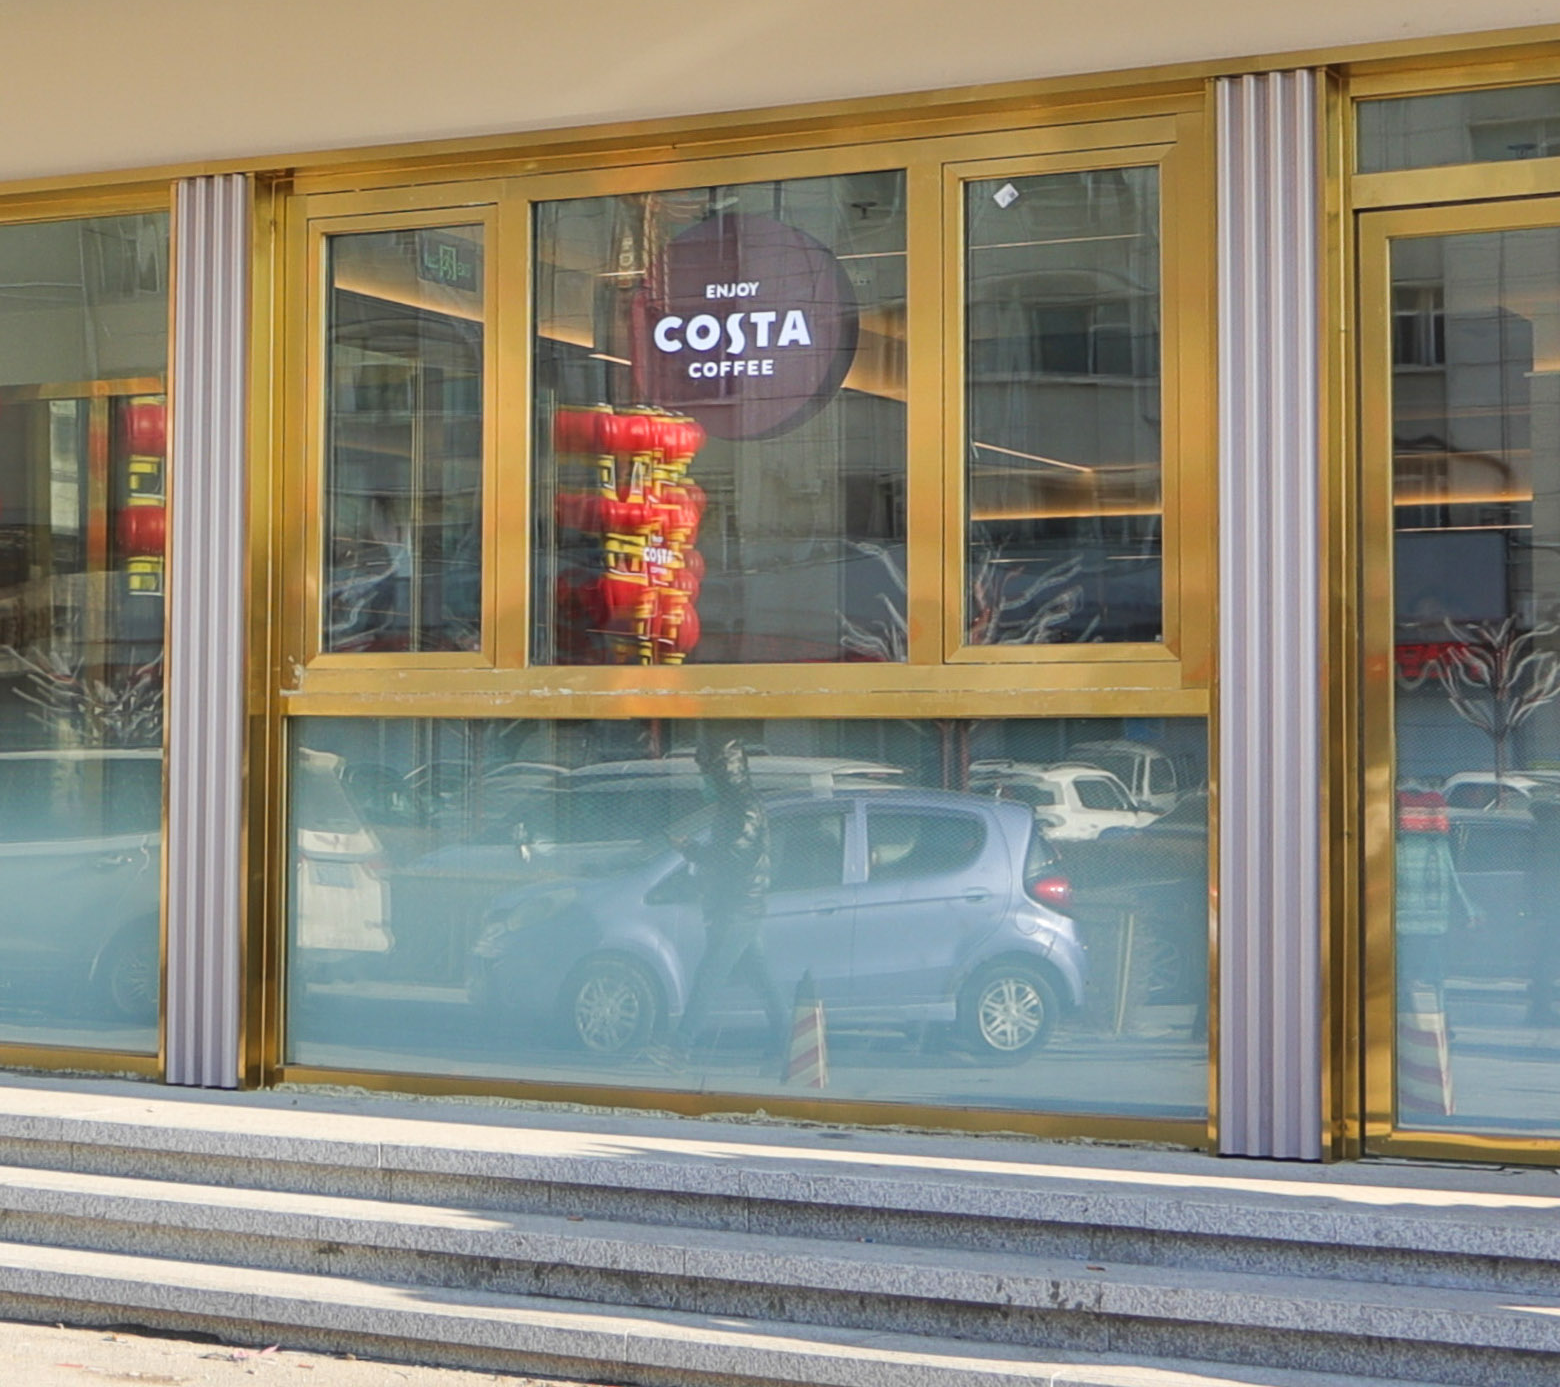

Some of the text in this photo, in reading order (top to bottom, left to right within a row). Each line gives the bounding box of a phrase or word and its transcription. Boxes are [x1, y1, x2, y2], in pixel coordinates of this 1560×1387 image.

[706, 281, 760, 299] ENJOY
[654, 309, 811, 355] COSTA
[688, 359, 774, 378] COFFEE
